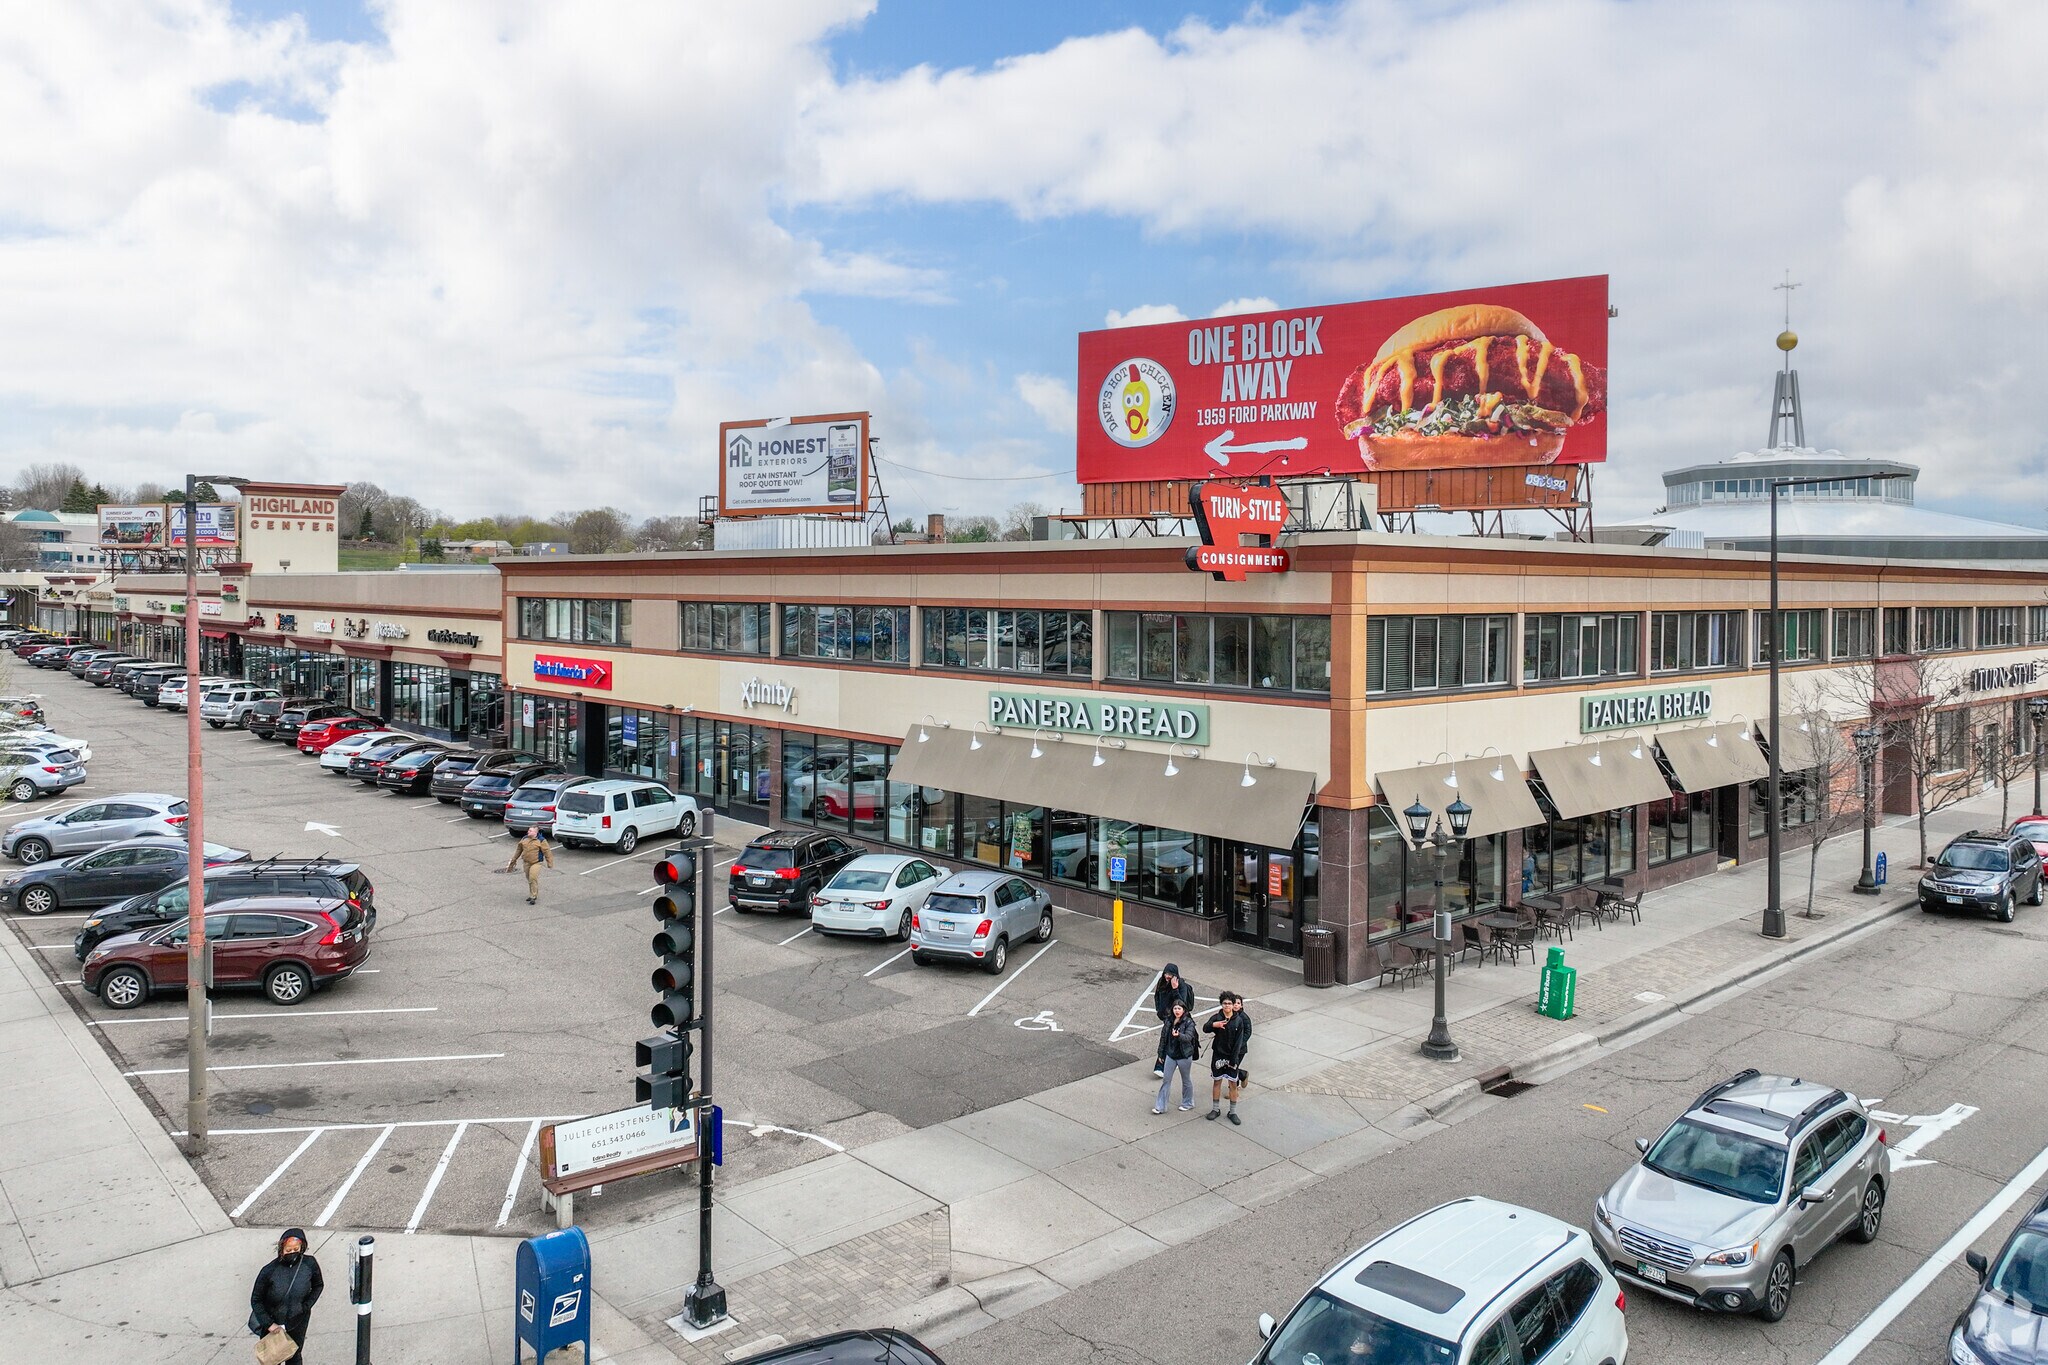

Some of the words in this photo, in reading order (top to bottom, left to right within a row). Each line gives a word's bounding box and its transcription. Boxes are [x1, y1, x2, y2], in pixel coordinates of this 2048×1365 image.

[1188, 325, 1235, 366] ONE
[1242, 316, 1324, 362] BLOCK
[1108, 367, 1127, 390] HOT
[1140, 363, 1172, 413] CHICKEN
[1220, 360, 1293, 402] AWAY
[1102, 390, 1119, 433] DAVE'S
[1197, 409, 1226, 427] 1959
[1229, 405, 1258, 424] FORD
[1260, 401, 1318, 422] PARKWAY
[758, 437, 827, 456] HONEST
[758, 457, 808, 466] EXTERIORS
[739, 480, 757, 488] ROOF
[758, 480, 782, 488] QUOTE
[768, 471, 797, 479] INSTANT
[250, 498, 335, 514] HIGHLAND
[1210, 496, 1240, 519] TURN
[1248, 499, 1281, 522] STYLE
[250, 520, 335, 532] CENTER
[1201, 552, 1284, 566] CONSIGNMENT
[740, 676, 795, 713] xfinity
[991, 697, 1092, 730] PANERA
[1101, 704, 1199, 739] BREAD
[1590, 695, 1658, 728] PANERA
[1662, 690, 1712, 718] BREAD
[563, 1128, 592, 1142] JULIE
[595, 1111, 663, 1134] CHRISTENSEN
[591, 1130, 646, 1149] 651.343.0466
